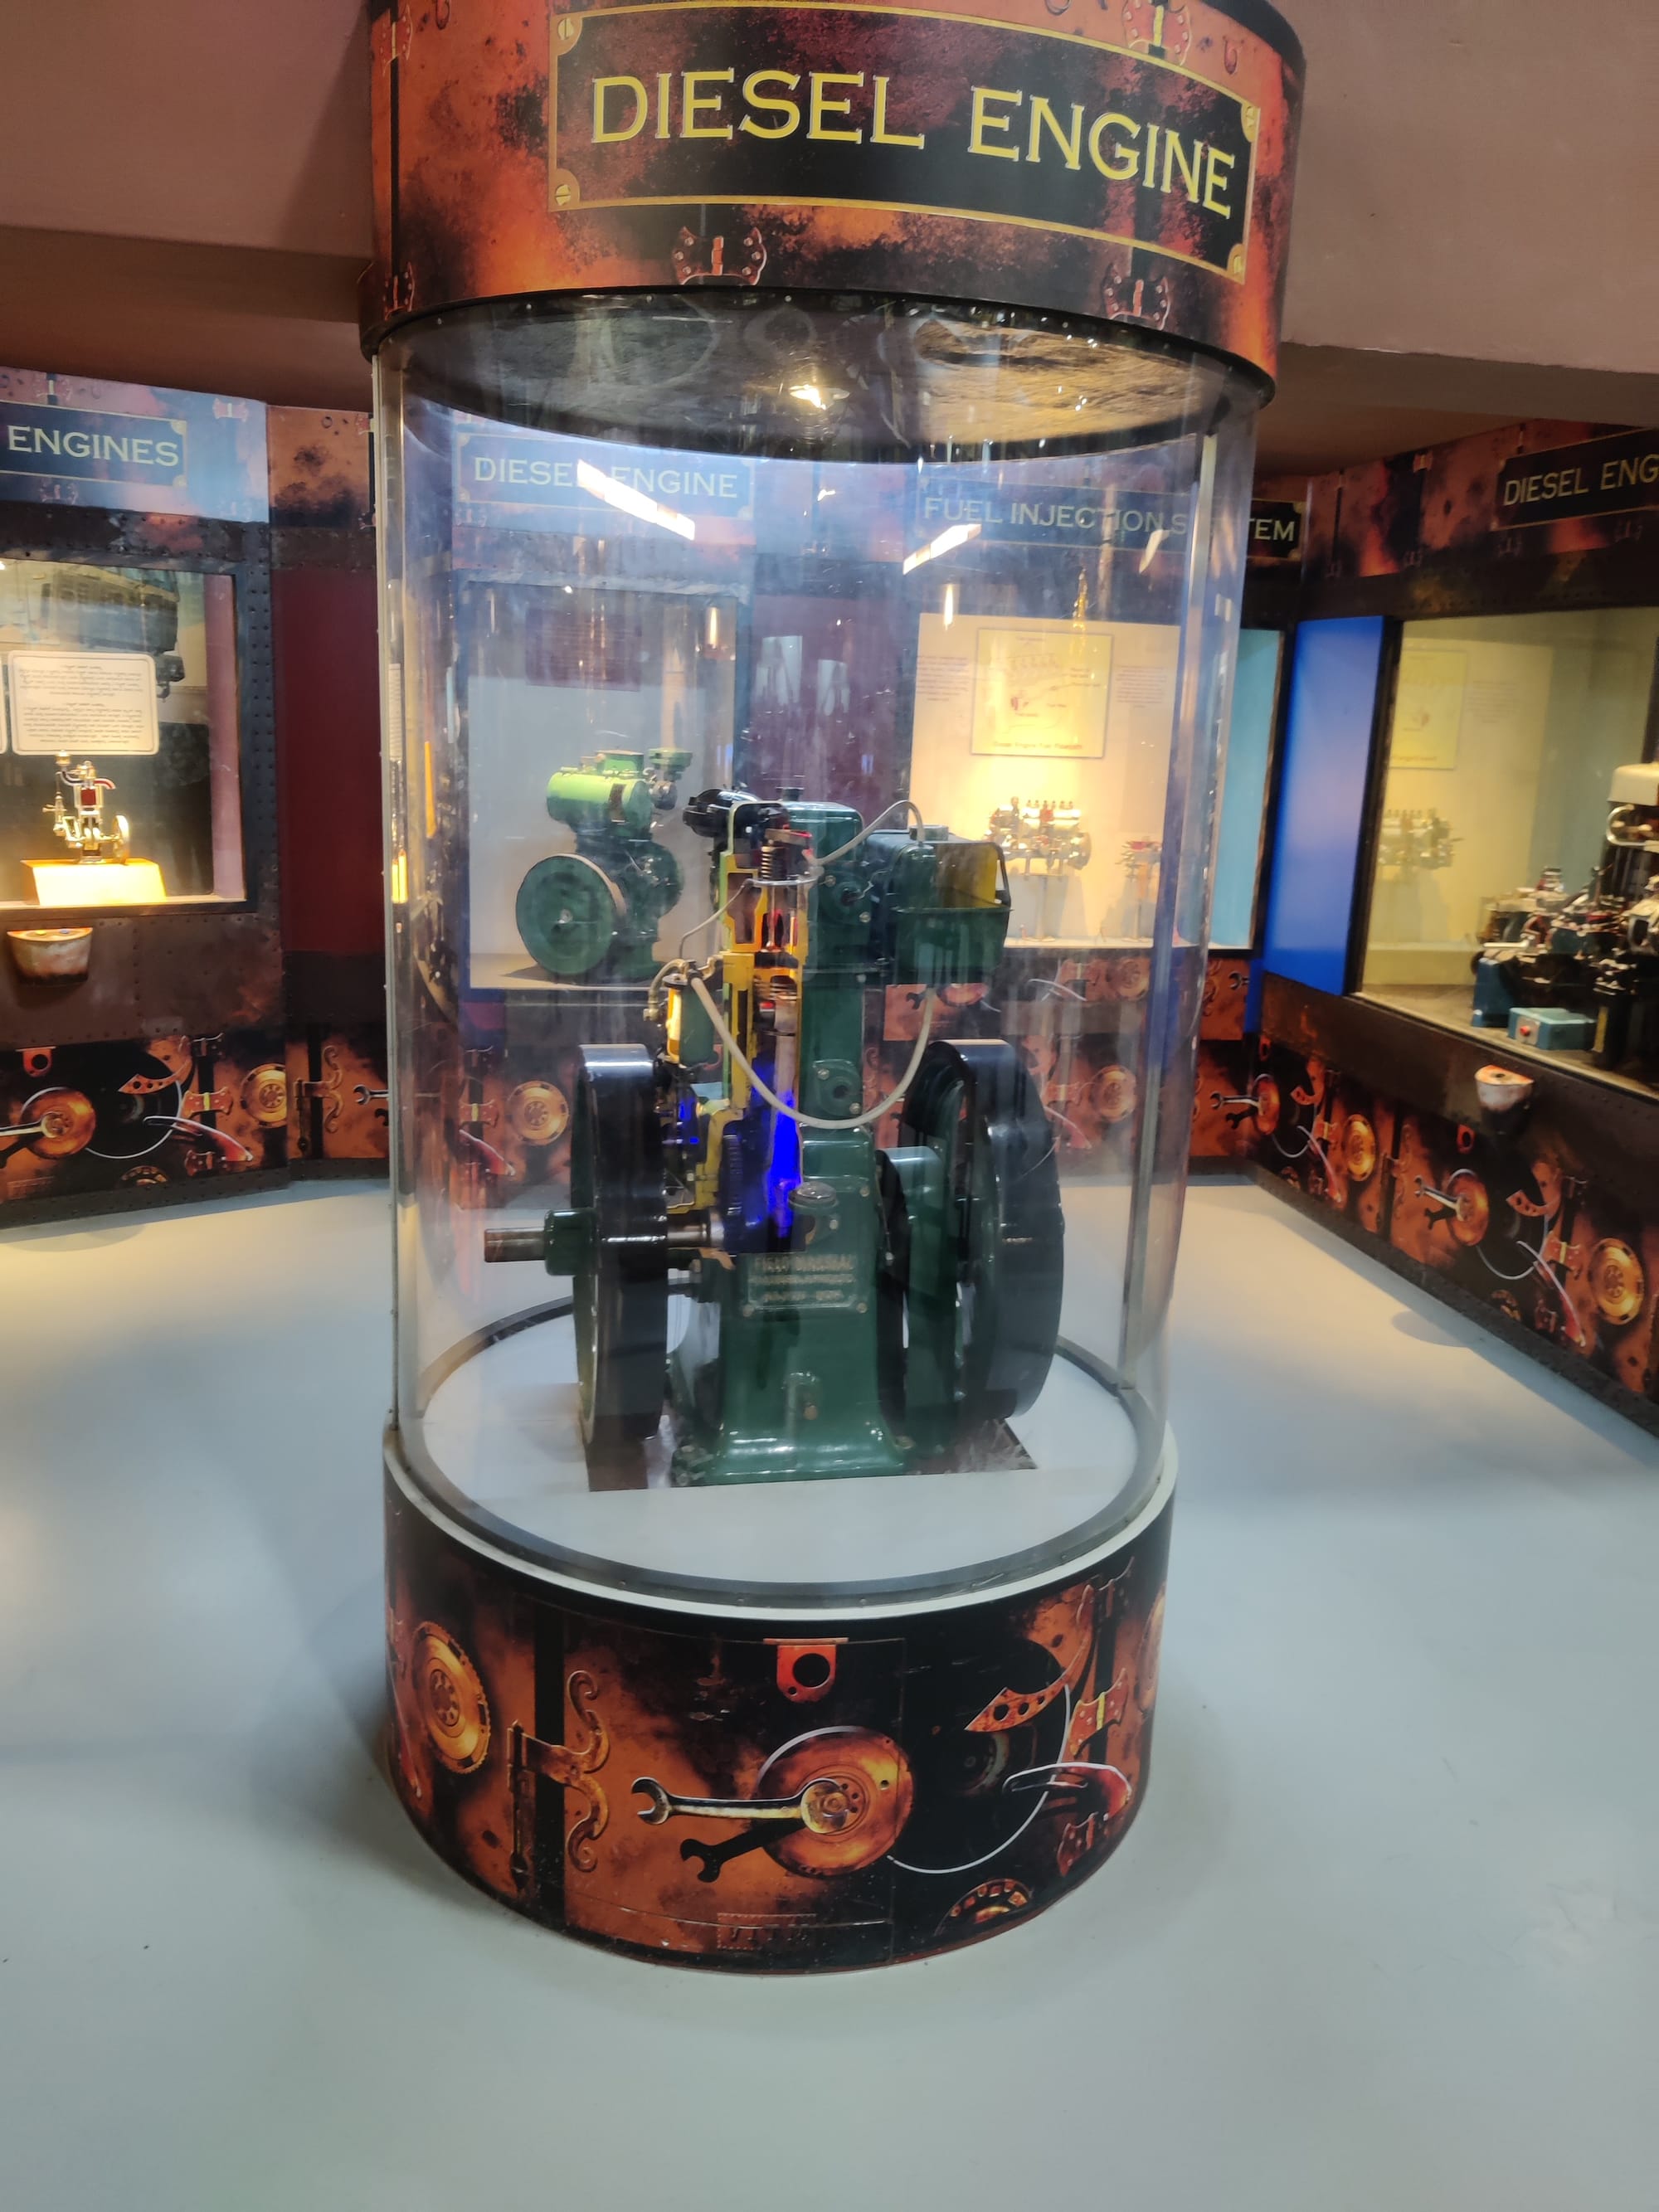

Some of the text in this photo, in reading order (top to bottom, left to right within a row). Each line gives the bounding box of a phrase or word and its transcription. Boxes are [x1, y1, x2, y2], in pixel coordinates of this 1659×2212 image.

[591, 67, 1236, 220] DIESEL ENGINE
[7, 425, 179, 467] ENGINES
[474, 457, 596, 489] DIESE
[1503, 467, 1589, 506] DIESEL
[924, 498, 1004, 524] FUEL
